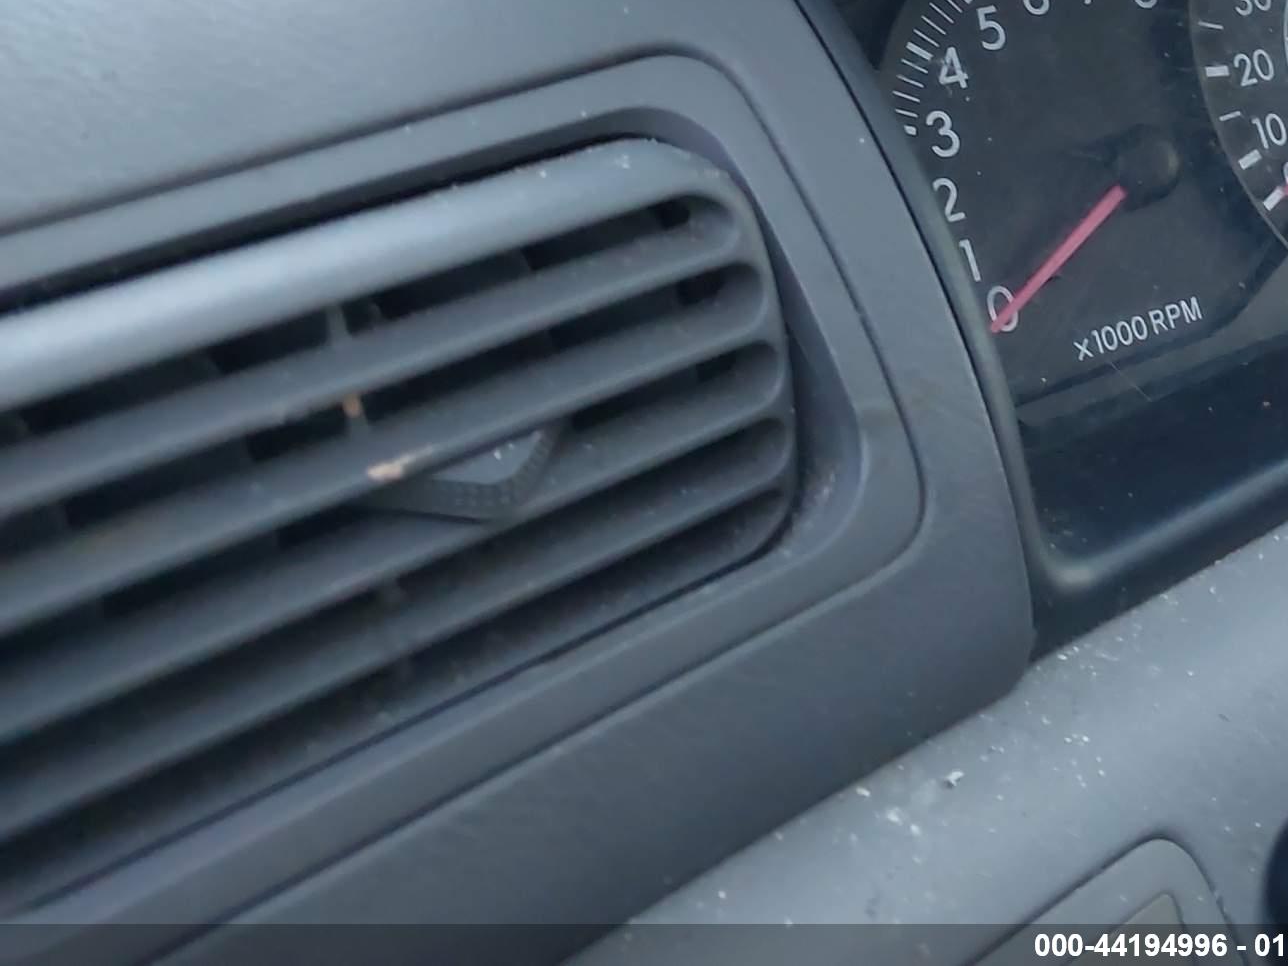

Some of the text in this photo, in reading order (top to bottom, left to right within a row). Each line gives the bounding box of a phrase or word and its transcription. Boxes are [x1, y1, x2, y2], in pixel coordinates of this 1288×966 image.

[976, 5, 1007, 51] 5
[939, 47, 968, 88] 4
[1234, 48, 1274, 87] 20
[925, 110, 960, 157] 3
[1253, 113, 1287, 150] 10
[933, 178, 966, 222] 2
[959, 239, 981, 282] 1
[986, 286, 1018, 331] 0
[1148, 296, 1203, 336] RPM
